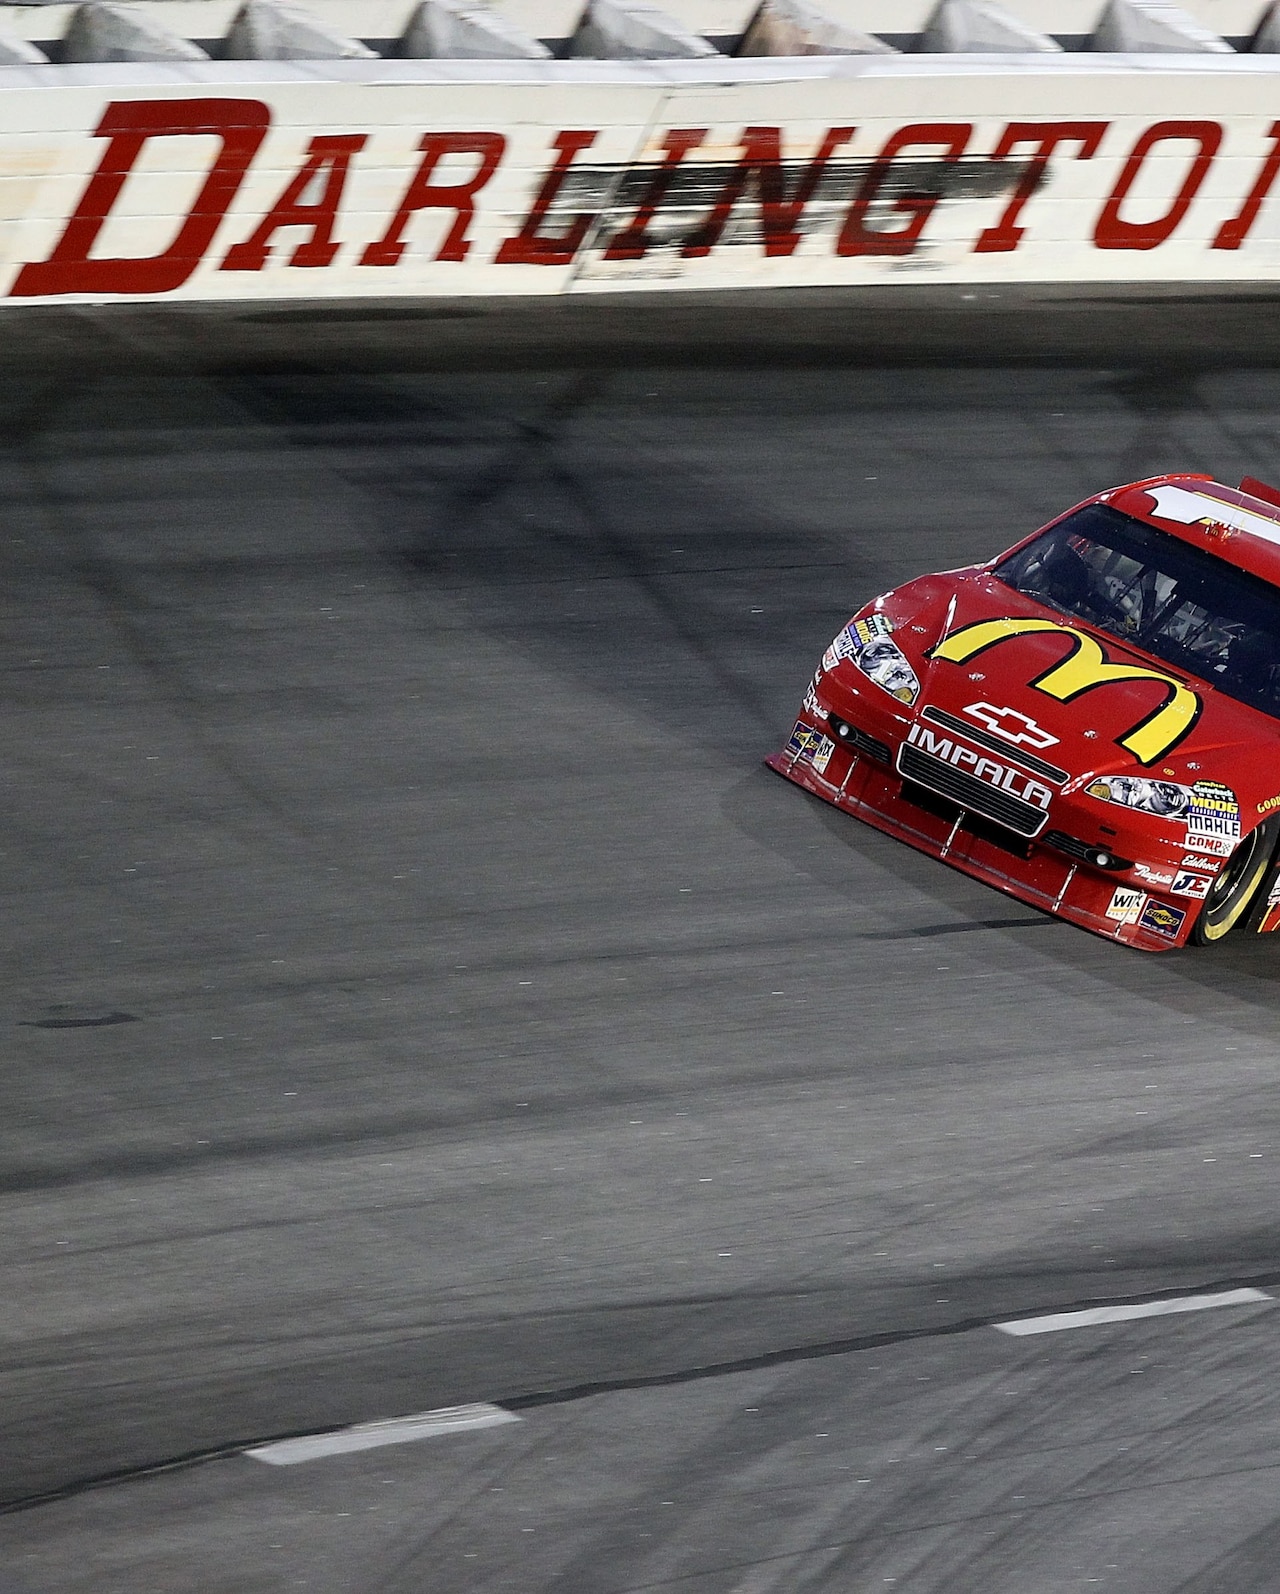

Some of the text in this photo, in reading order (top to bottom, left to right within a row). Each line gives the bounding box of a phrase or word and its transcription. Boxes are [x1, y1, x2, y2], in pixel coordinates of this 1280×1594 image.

[907, 723, 1055, 810] IMPALA
[1190, 796, 1239, 814] MOOG
[1189, 815, 1240, 837] MAHLE
[1188, 836, 1222, 850] COMP
[1181, 854, 1221, 873] Edelbrock
[1173, 875, 1209, 893] JE
[1145, 908, 1180, 926] SUNOCO
